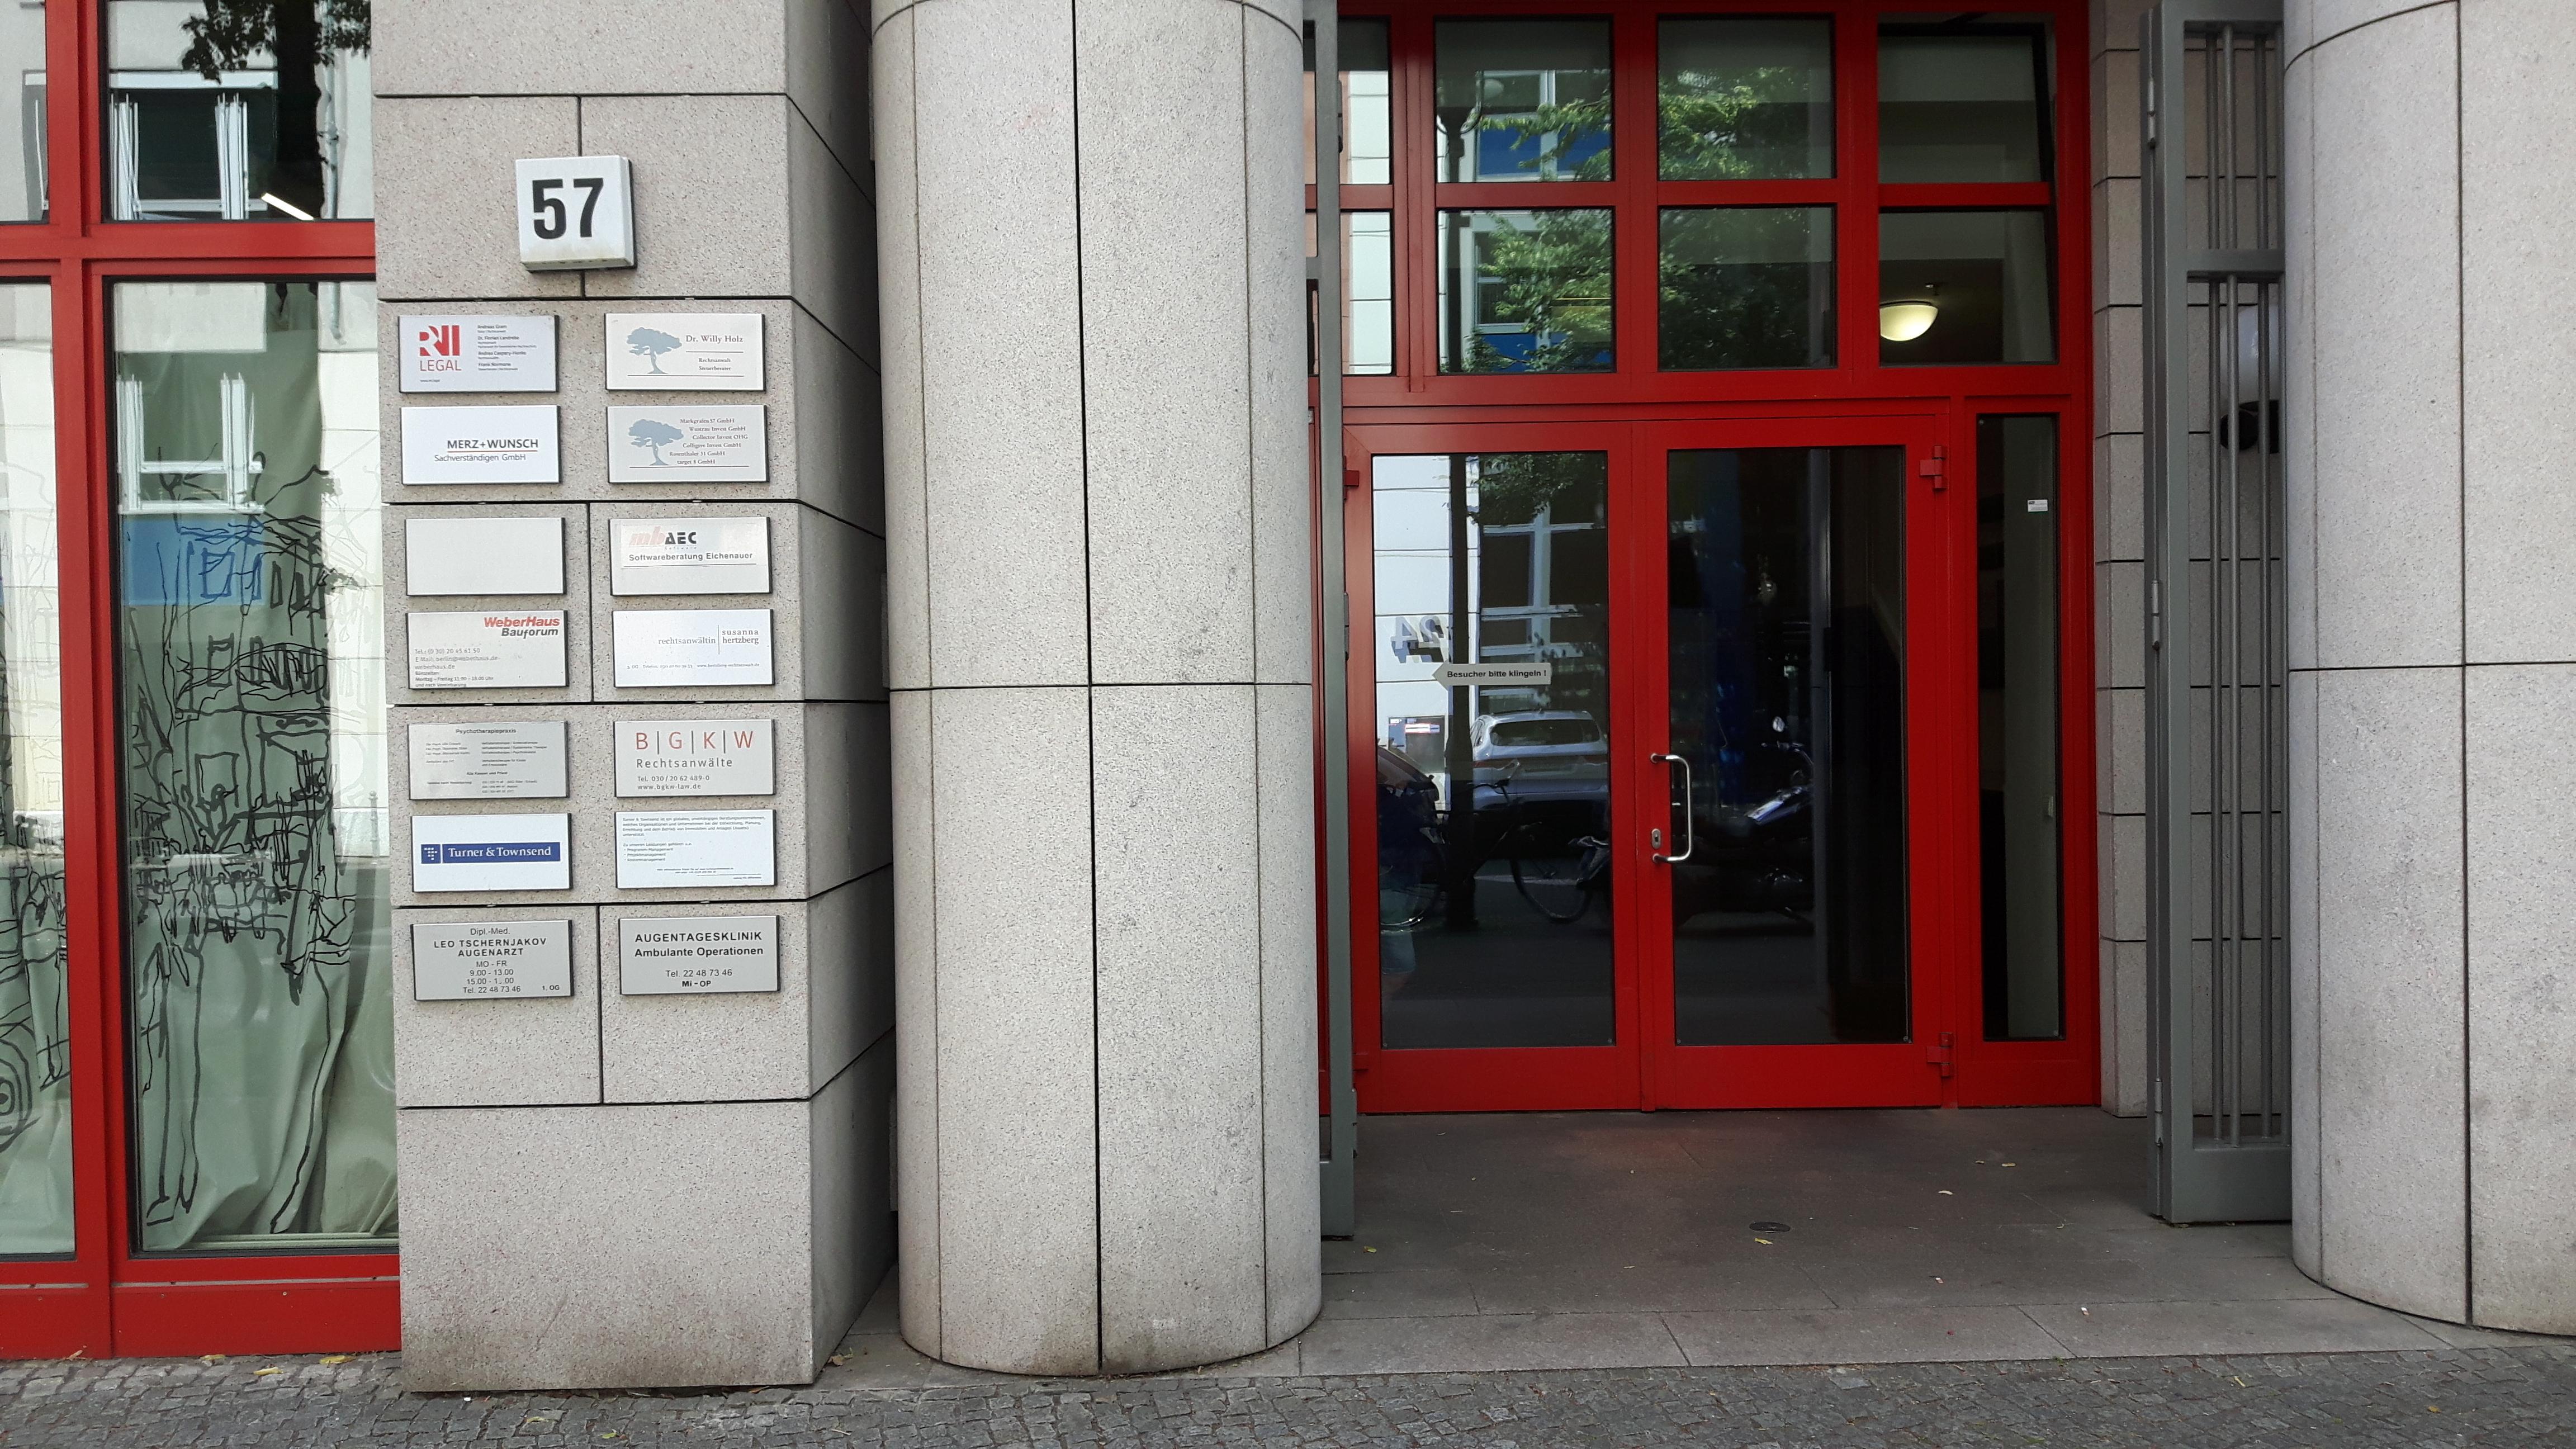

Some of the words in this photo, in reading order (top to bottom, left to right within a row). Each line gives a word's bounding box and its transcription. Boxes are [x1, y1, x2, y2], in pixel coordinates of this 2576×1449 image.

[532, 178, 604, 239] 57
[701, 335, 722, 344] Willy
[420, 359, 462, 371] LEGAL
[447, 439, 538, 449] MERZ+WUNSCH
[434, 454, 499, 462] Sachverständigen
[484, 616, 560, 627] WeberHaus
[501, 628, 558, 640] Bauforum
[658, 637, 716, 645] rechtsanwältin
[722, 636, 759, 645] hertzberg
[1509, 670, 1541, 678] klingeln
[636, 757, 733, 768] Rechtsanwälte
[448, 847, 483, 858] Turner
[486, 847, 495, 856] &
[496, 846, 551, 857] Townsend
[470, 927, 510, 936] Dipl.-Med.
[635, 931, 763, 943] AUGENTAGESKLINIK
[434, 940, 454, 948] LEO
[459, 937, 547, 948] TSCHERNJAKOV
[458, 948, 524, 957] AUGENARZT
[635, 948, 693, 957] Ambulante
[697, 947, 763, 958] Operationen
